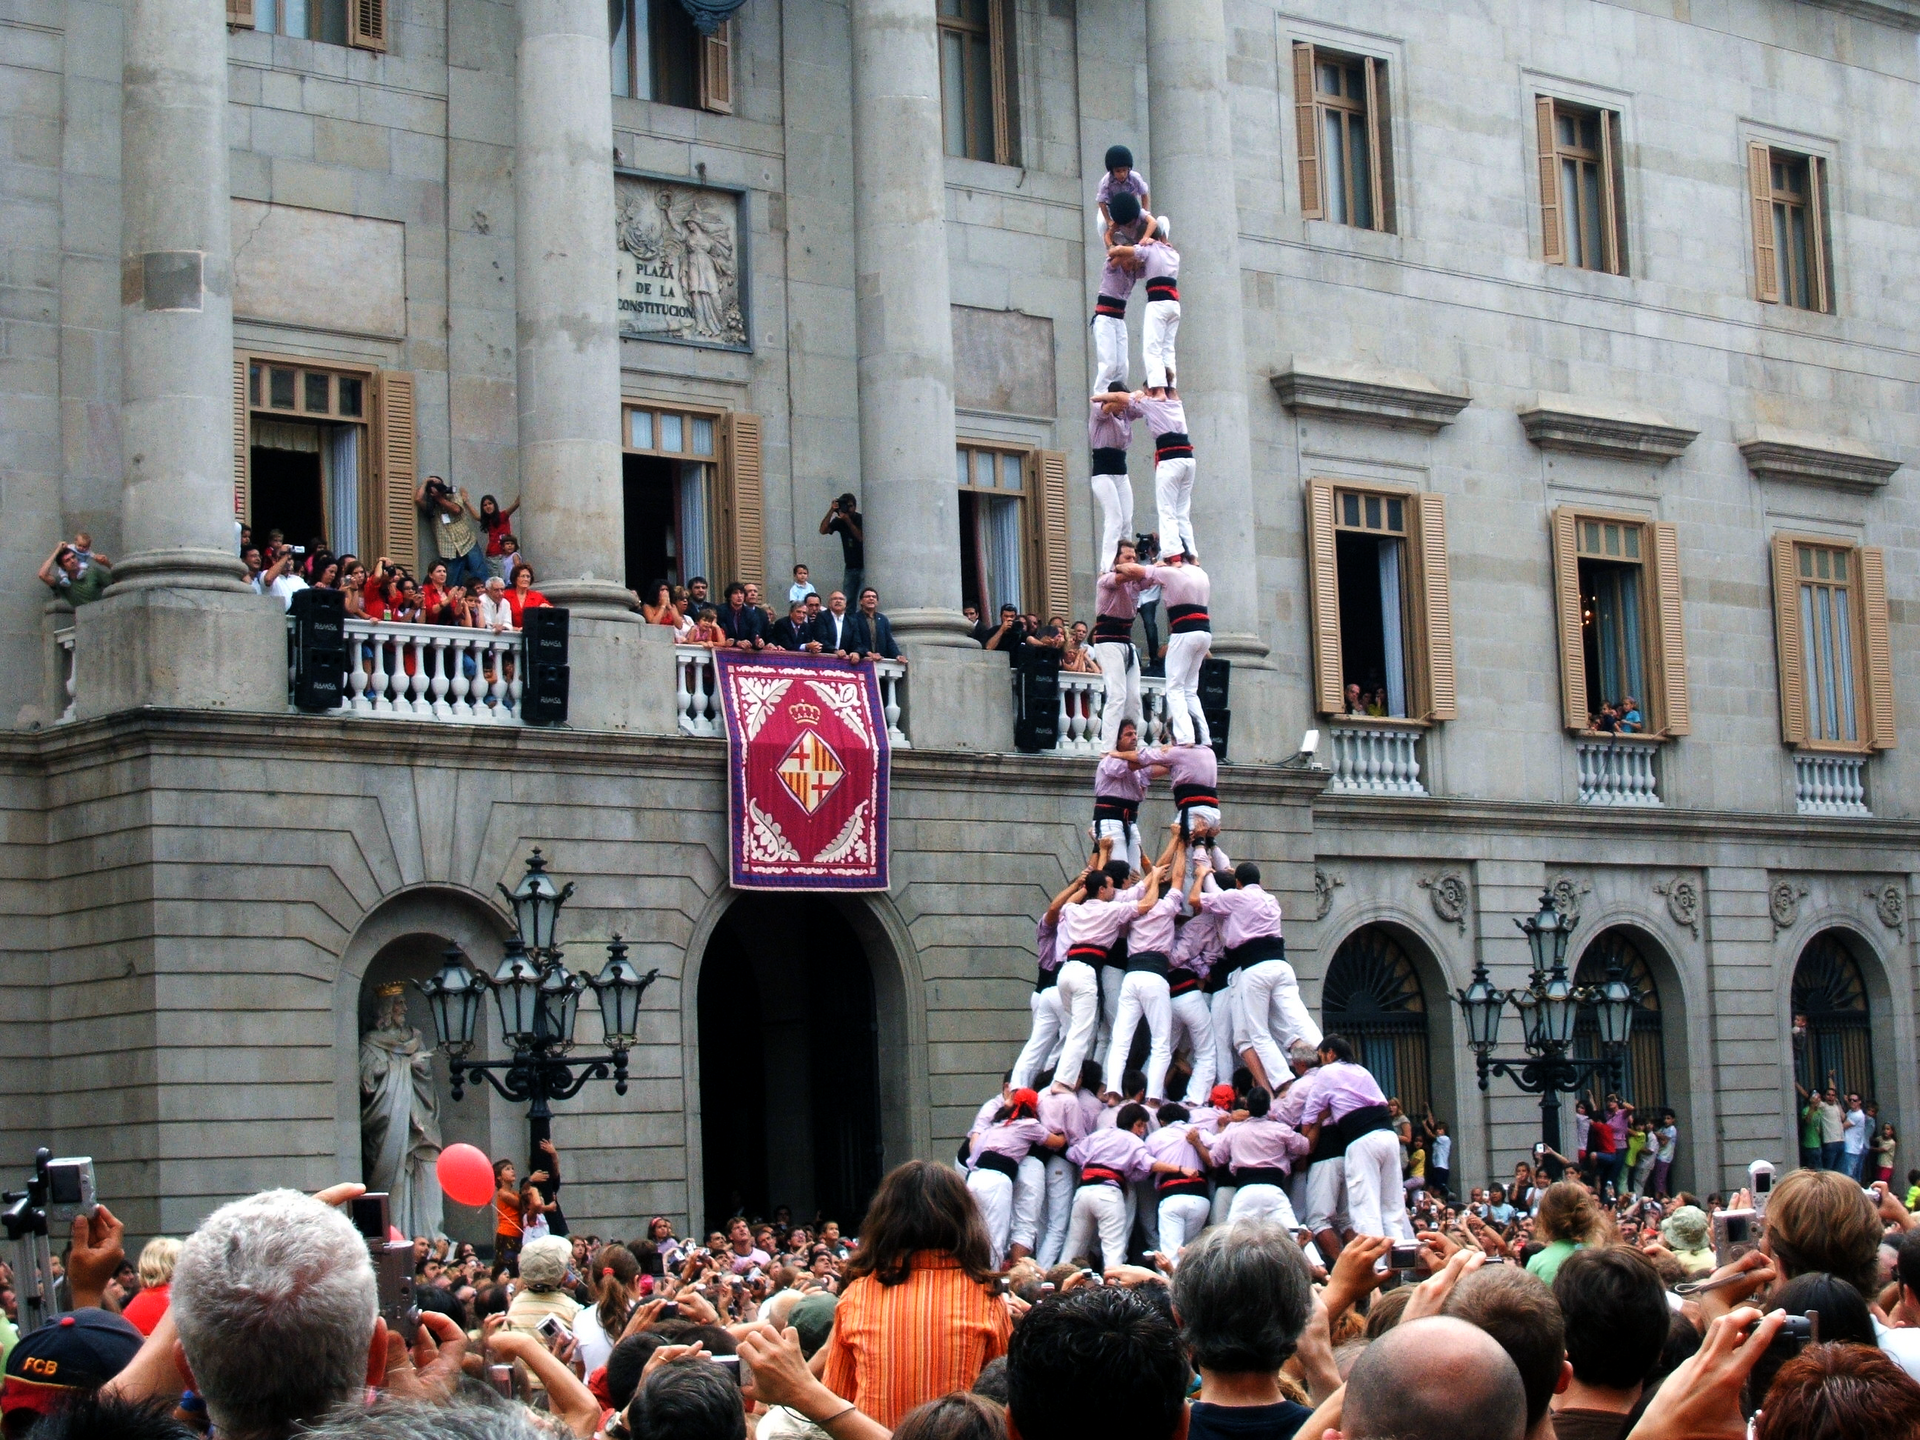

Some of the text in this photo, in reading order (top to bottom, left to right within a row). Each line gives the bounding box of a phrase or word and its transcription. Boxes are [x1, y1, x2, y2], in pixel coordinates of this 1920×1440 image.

[636, 263, 674, 279] PLAZA
[636, 282, 675, 298] DE LA
[23, 1357, 58, 1375] FCB
